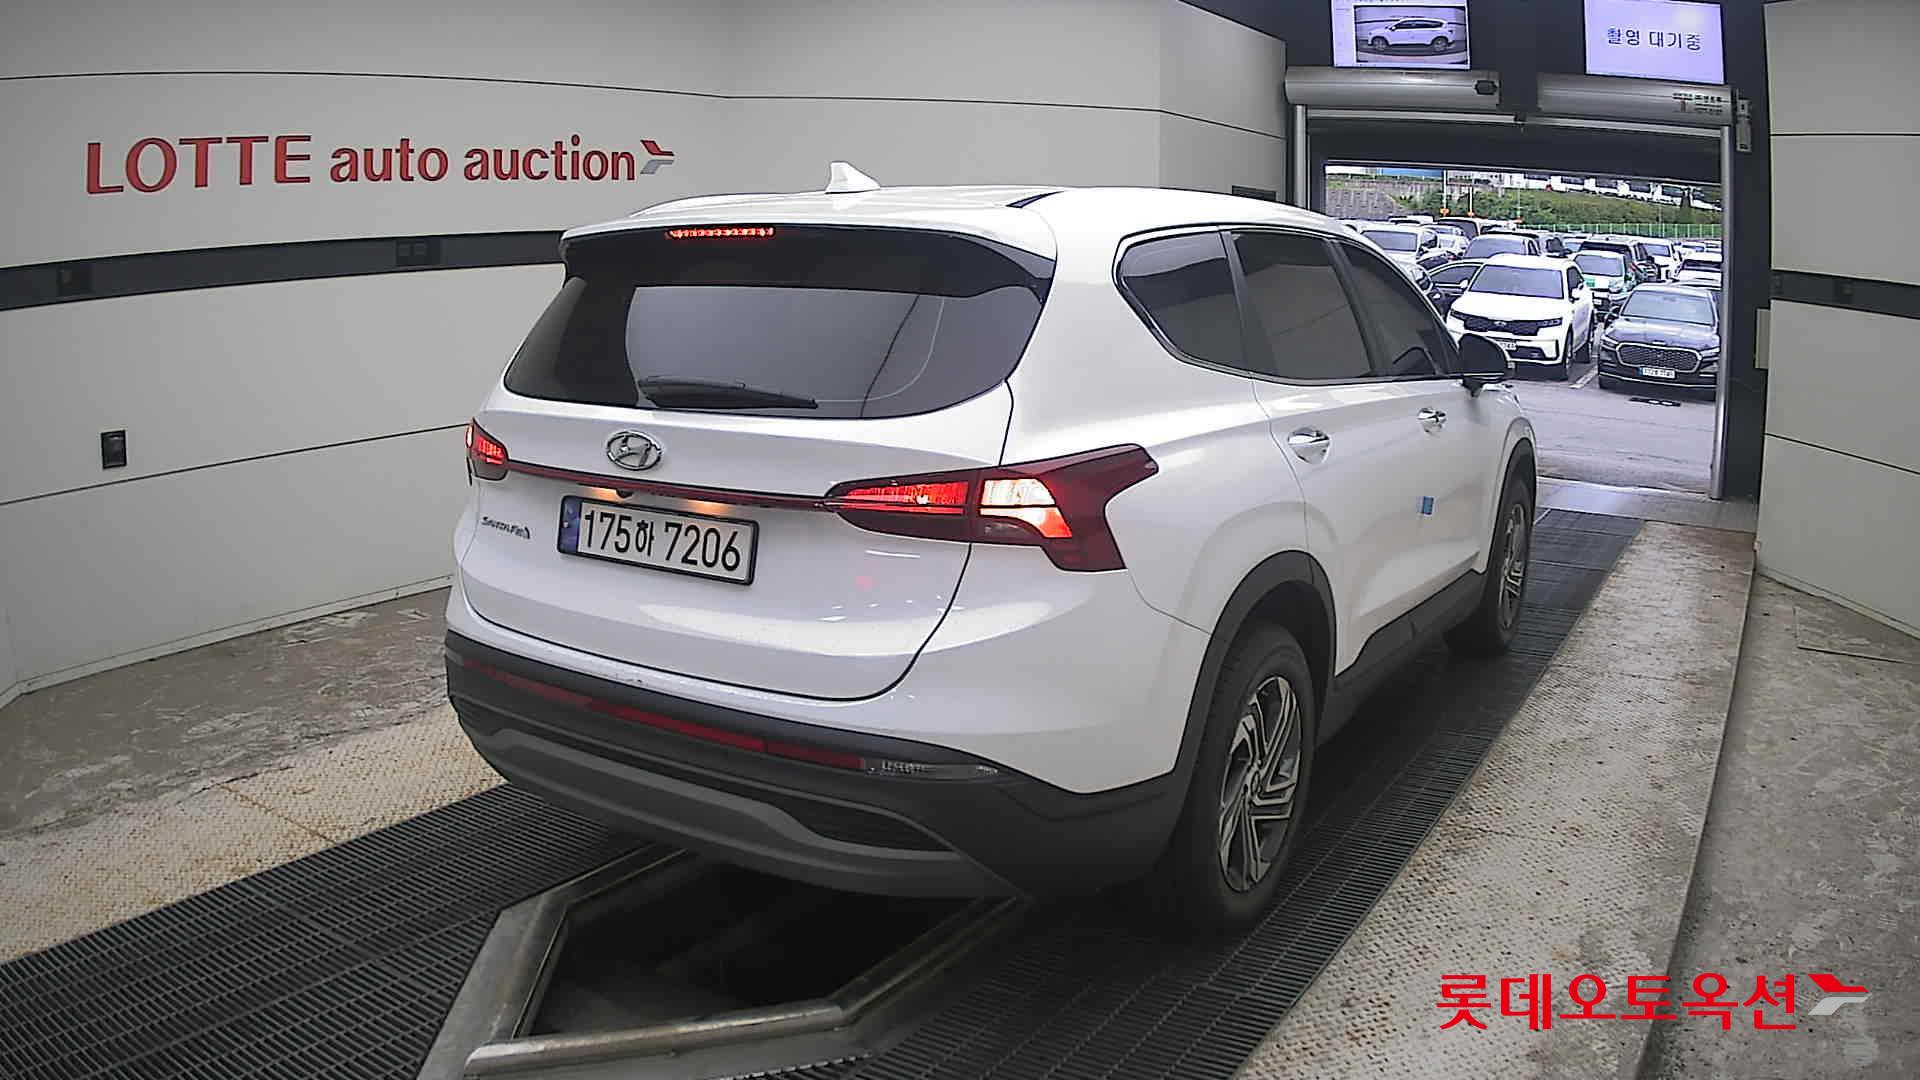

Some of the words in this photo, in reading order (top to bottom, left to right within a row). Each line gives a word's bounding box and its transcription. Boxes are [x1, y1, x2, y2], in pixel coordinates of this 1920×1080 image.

[1607, 28, 1641, 46] 촬영
[86, 135, 311, 194] LOTTE
[329, 138, 449, 182] auto
[463, 134, 636, 182] auction
[584, 510, 655, 557] 175하
[664, 521, 741, 572] 7206
